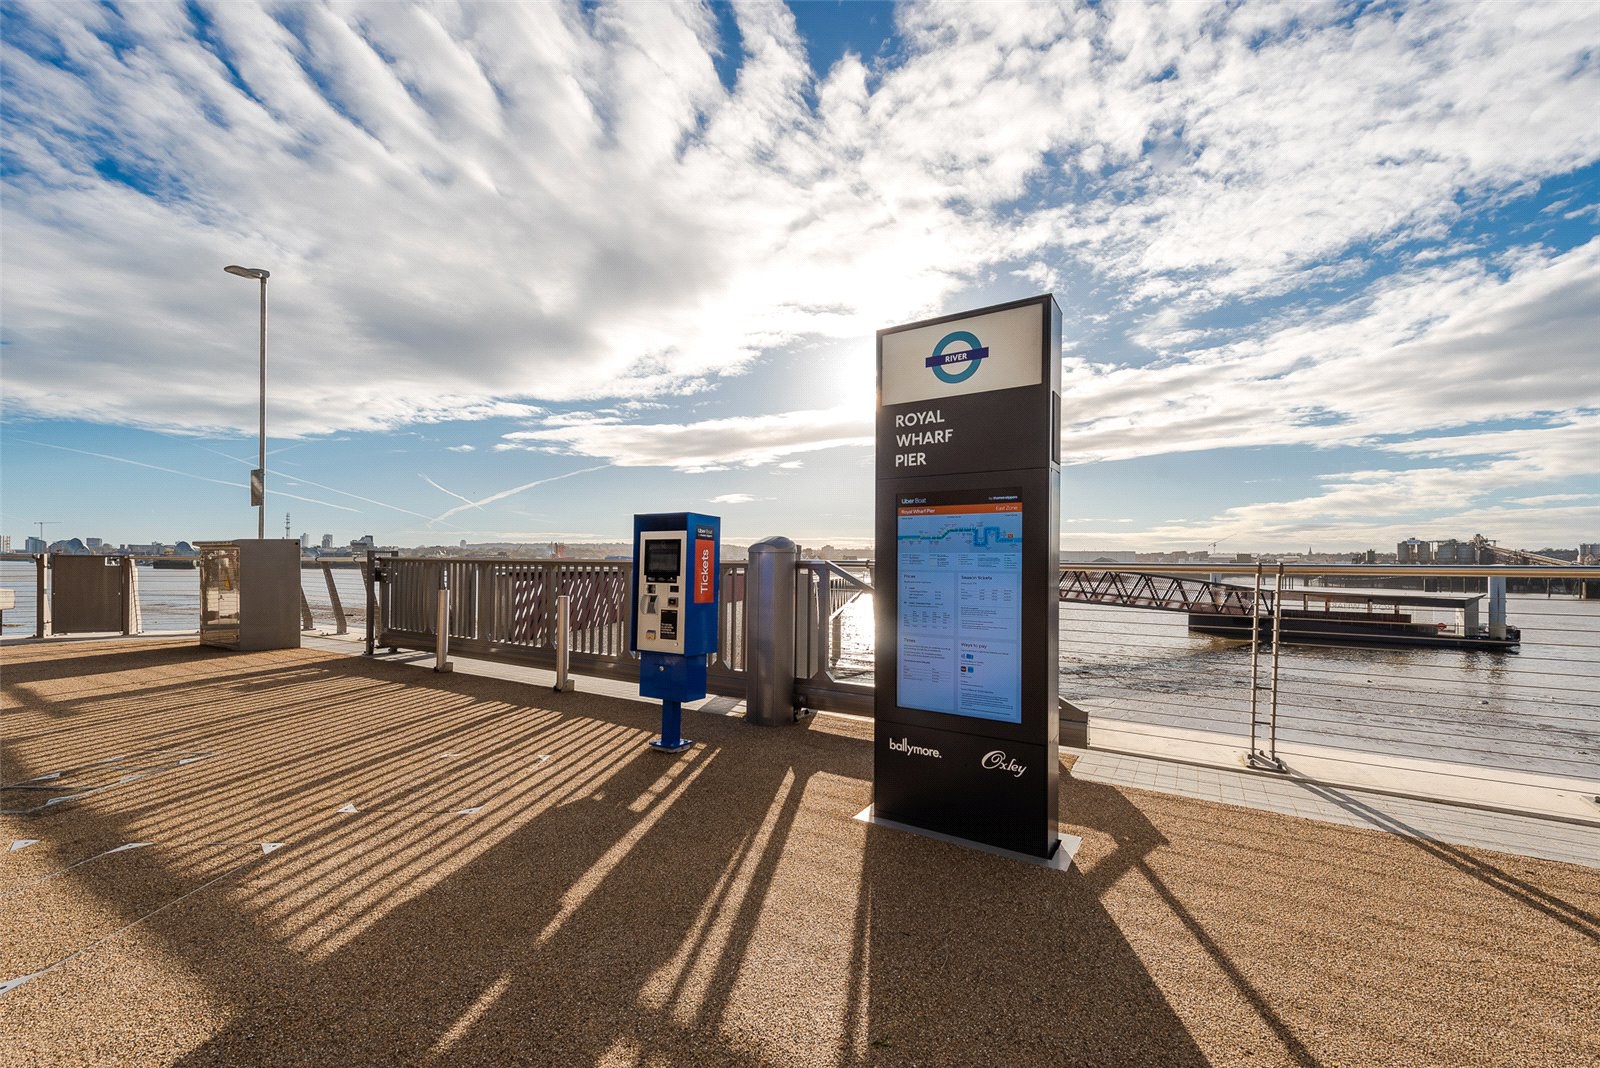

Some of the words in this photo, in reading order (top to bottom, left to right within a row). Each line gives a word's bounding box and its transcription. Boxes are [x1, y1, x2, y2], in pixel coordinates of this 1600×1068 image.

[945, 352, 968, 363] RIVER
[895, 409, 945, 428] ROYAL
[896, 428, 954, 447] WHARF
[895, 452, 927, 468] PIER
[700, 549, 709, 594] Tickets
[889, 737, 942, 759] ballymore.
[981, 750, 1027, 778] Oxley
